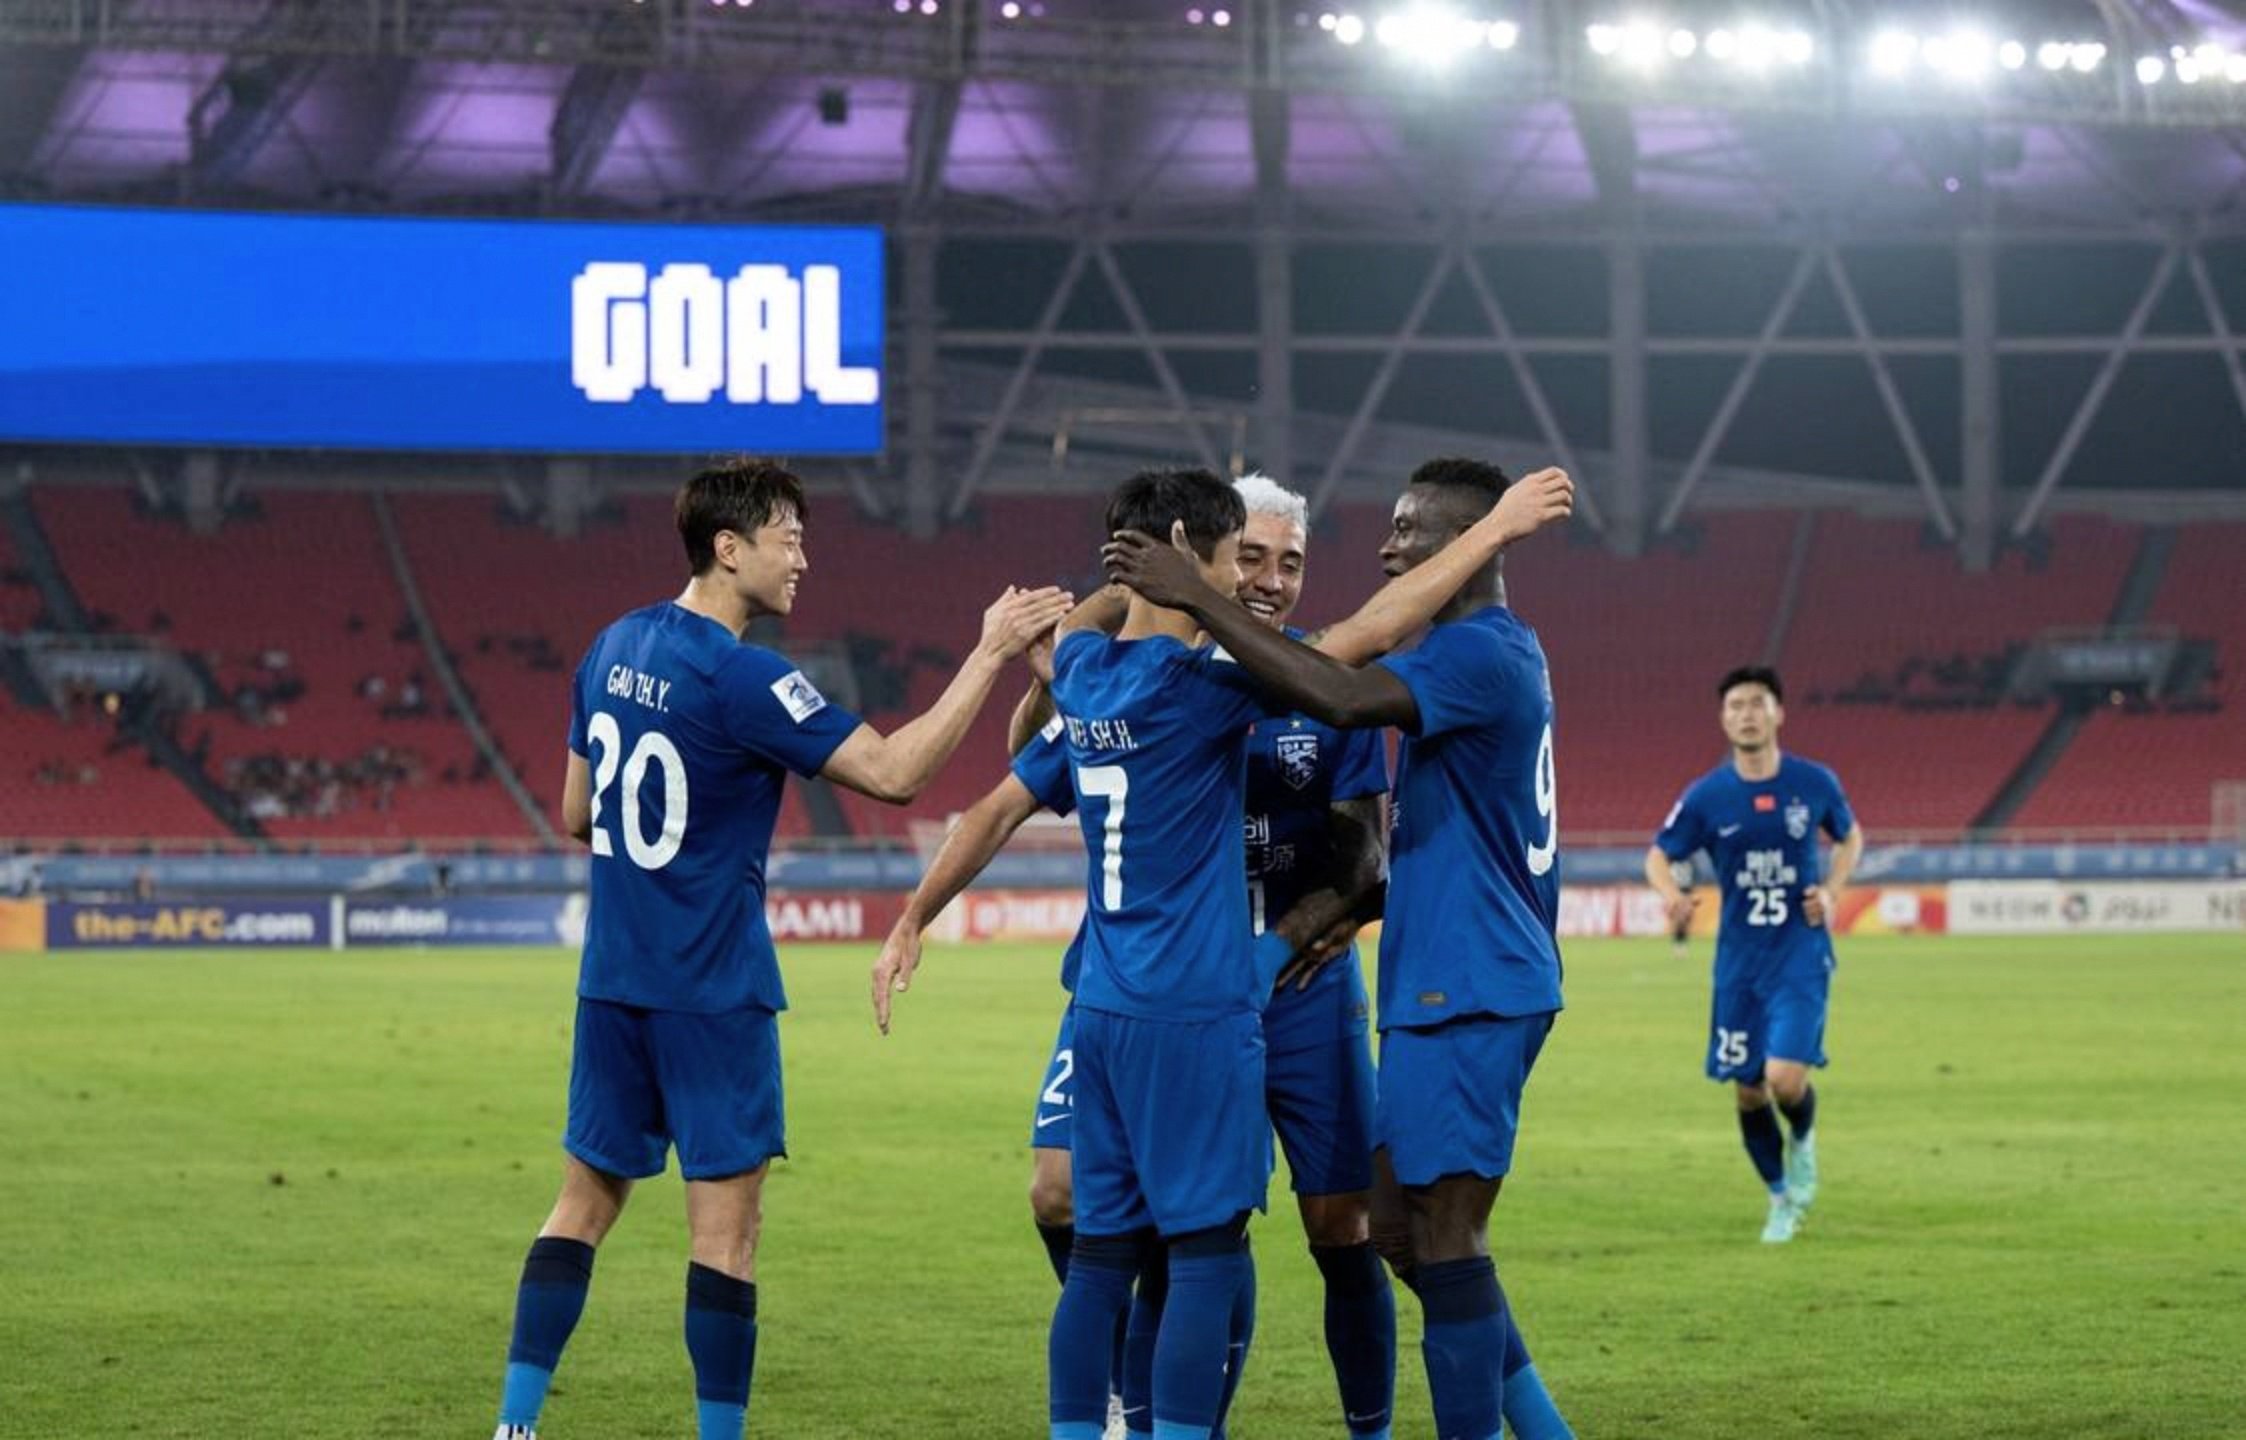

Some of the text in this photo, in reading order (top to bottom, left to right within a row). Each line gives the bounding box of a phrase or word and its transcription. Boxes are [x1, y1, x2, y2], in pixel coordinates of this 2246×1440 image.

[571, 262, 879, 404] GOAL
[607, 664, 634, 699] GAO
[1090, 719, 1139, 750] SH.H.
[588, 711, 688, 870] 20
[1527, 723, 1557, 876] 9
[1078, 765, 1128, 911] 7
[75, 907, 315, 942] the-AFC.com
[1747, 888, 1788, 927] 25
[1716, 1026, 1749, 1066] 25
[1042, 1049, 1073, 1107] 2
